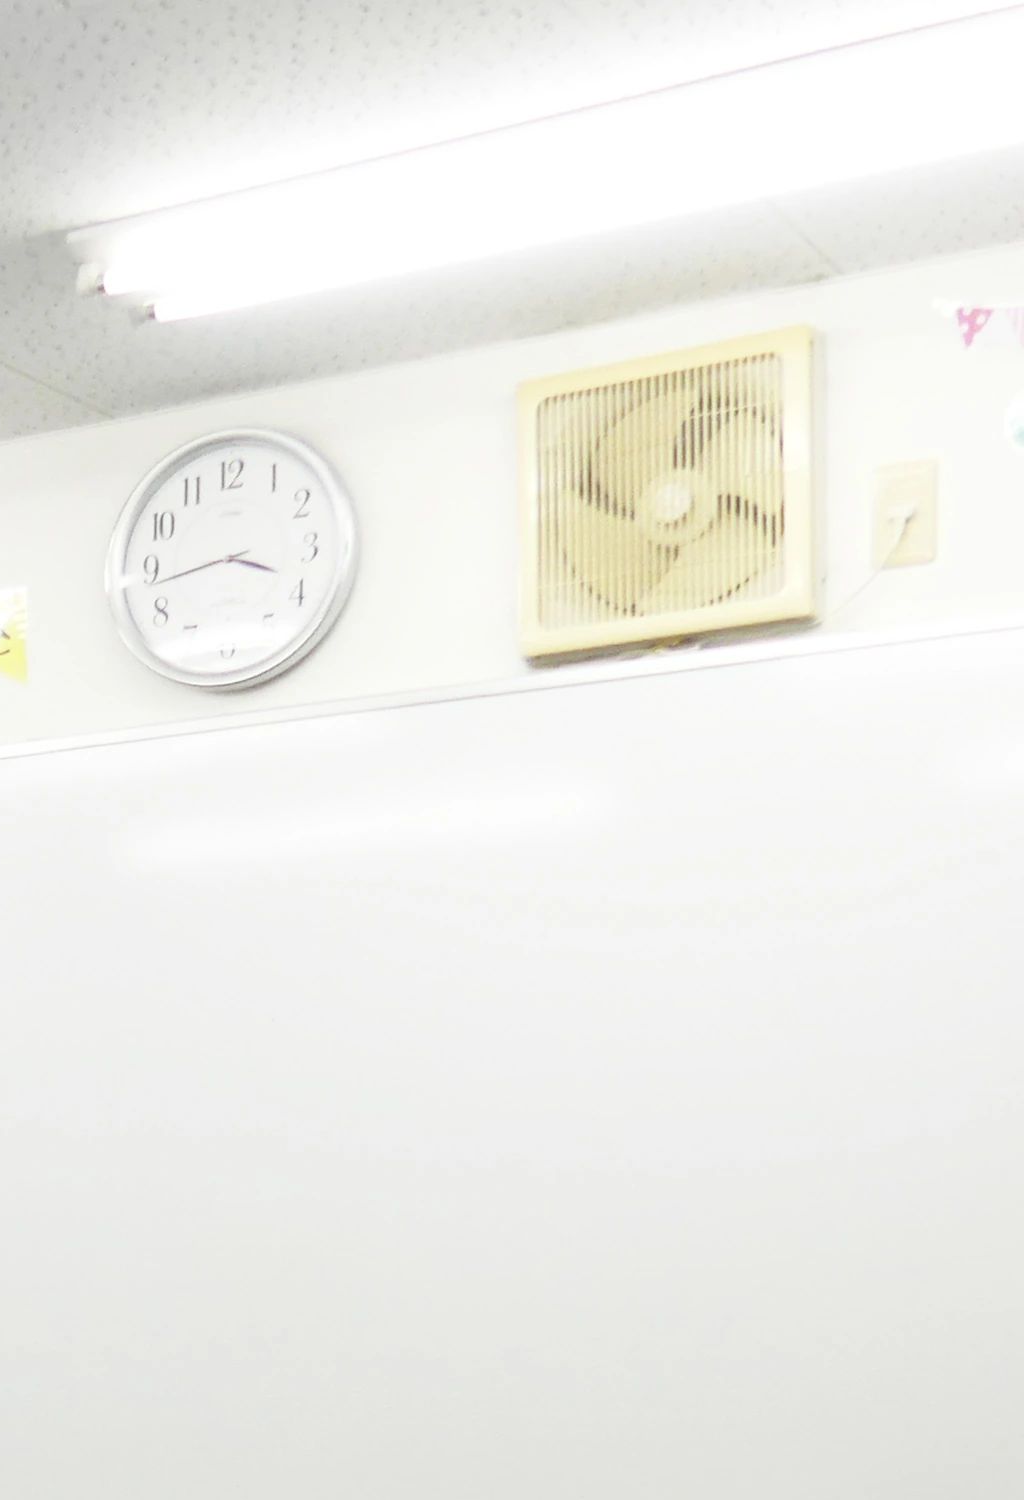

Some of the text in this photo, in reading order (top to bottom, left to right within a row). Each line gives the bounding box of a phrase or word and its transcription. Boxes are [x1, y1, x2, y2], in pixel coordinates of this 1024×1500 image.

[221, 459, 244, 490] 12
[184, 477, 201, 506] 11
[293, 488, 311, 519] 2
[152, 512, 175, 541] 10
[301, 533, 318, 562] 3
[143, 554, 159, 585] 9
[288, 578, 304, 607] 4
[153, 597, 169, 627] 8
